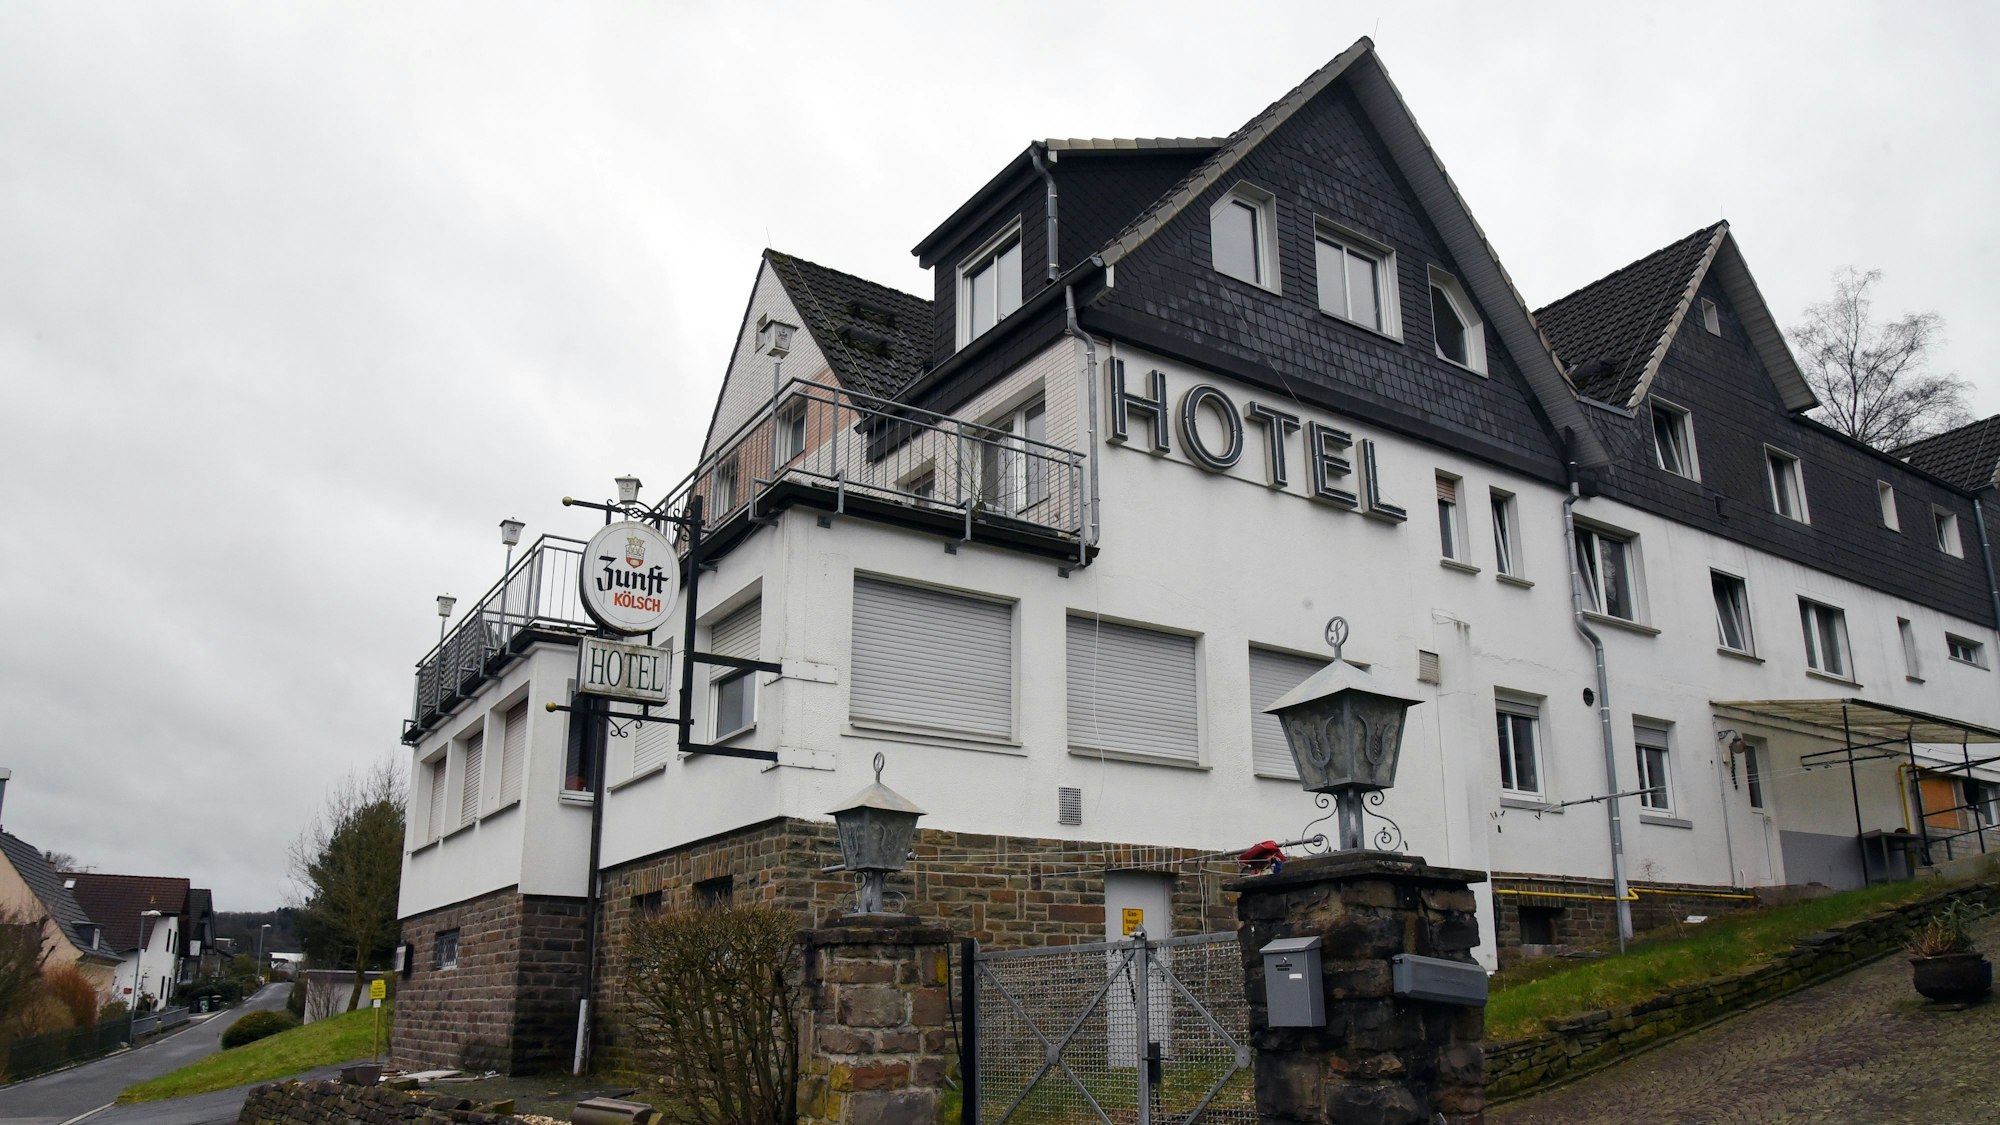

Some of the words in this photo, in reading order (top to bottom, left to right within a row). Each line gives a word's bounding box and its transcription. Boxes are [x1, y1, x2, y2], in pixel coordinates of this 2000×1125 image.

[1104, 356, 1407, 524] HOTEL
[596, 551, 669, 599] Zunft
[614, 591, 661, 612] KÖLSCH
[588, 647, 664, 692] HOTEL
